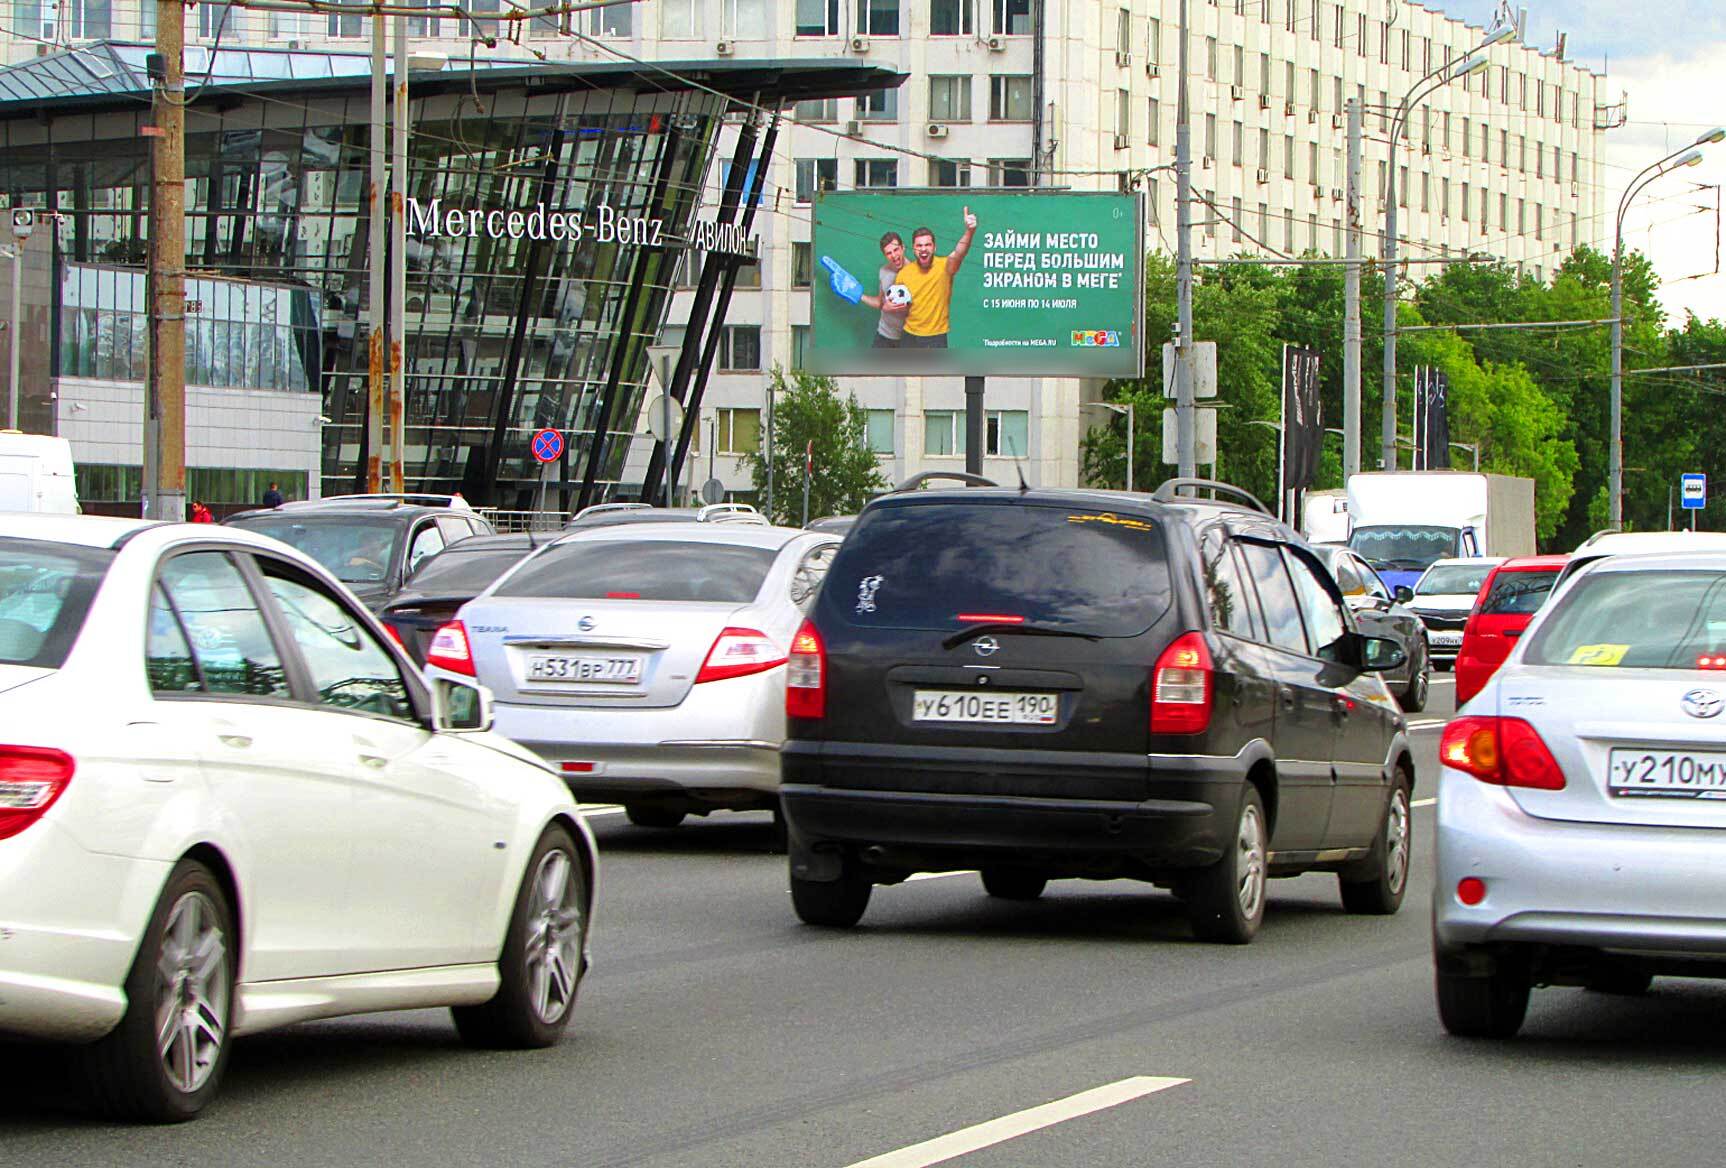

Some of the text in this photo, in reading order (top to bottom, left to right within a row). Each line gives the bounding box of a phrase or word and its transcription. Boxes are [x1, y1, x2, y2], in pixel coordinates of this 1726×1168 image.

[406, 197, 663, 246] Mercedes-Benz
[695, 219, 747, 255] АВИЛОН
[983, 229, 1098, 249] ЗАЙМИ МЕСТО
[983, 253, 1124, 270] ПЕРЕД БОЛЬШИМ
[983, 272, 1057, 288] ЭКРАНОМ
[1062, 273, 1072, 288] В
[983, 299, 1077, 308] С 15 ИЮНЯ ПО 14 ИЮЛЯ
[607, 659, 635, 674] 777
[922, 695, 1049, 719] У610ЕЕ 190
